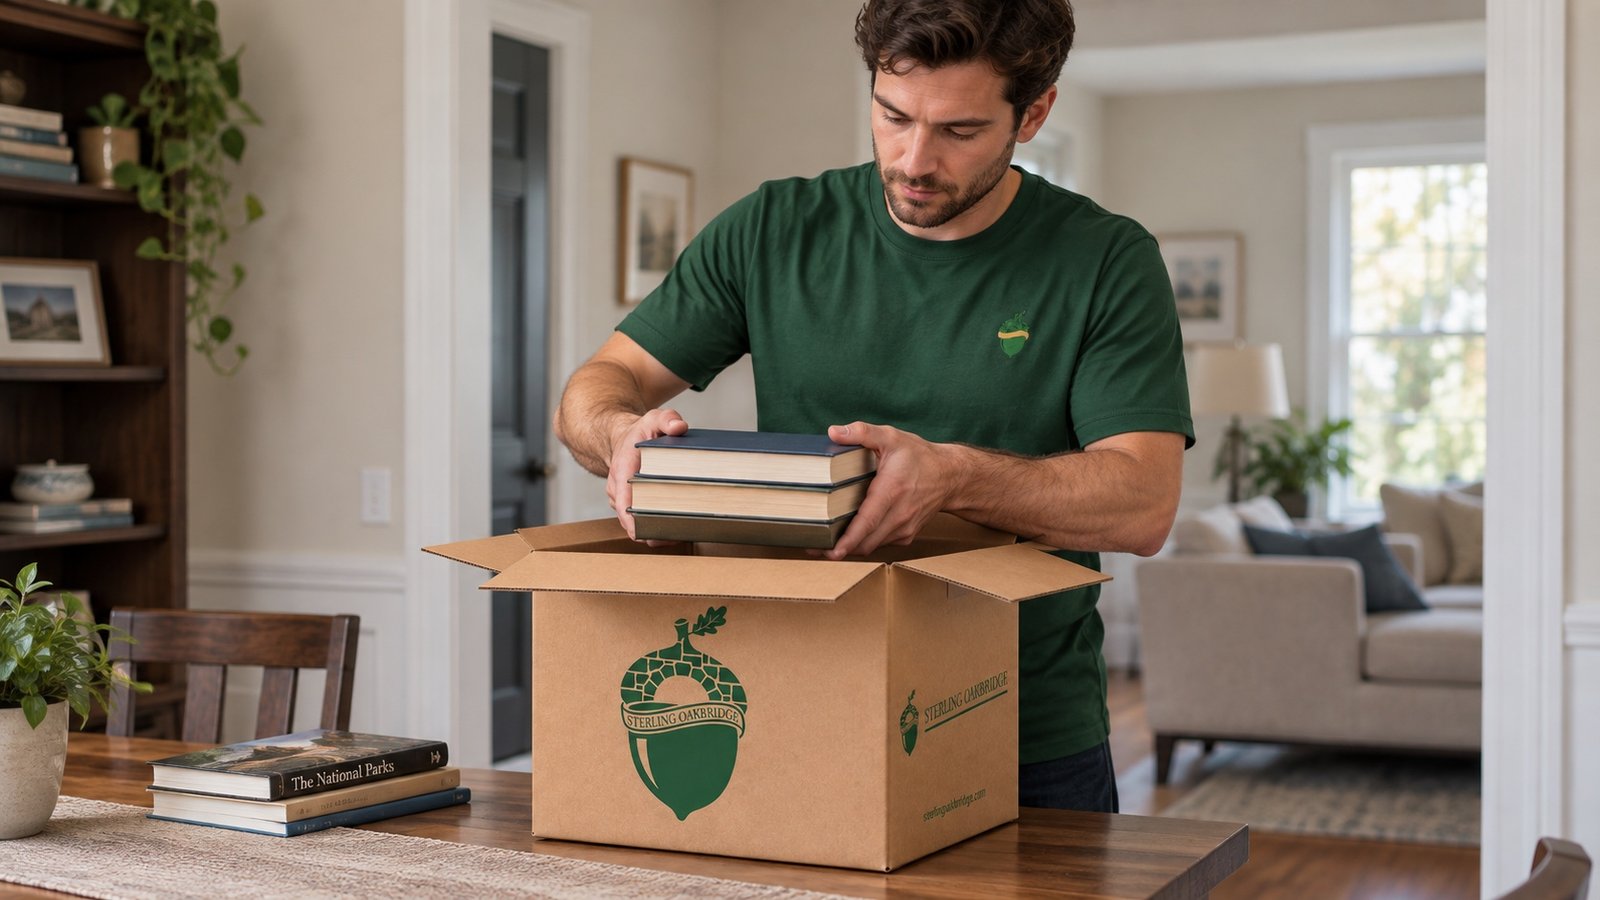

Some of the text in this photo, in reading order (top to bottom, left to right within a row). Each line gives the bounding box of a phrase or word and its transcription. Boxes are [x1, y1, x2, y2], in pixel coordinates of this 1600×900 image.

[924, 670, 1008, 724] STERLING OAKBRIDGE
[627, 707, 739, 728] STERLING OAKBRIDGE
[291, 759, 395, 792] The National Parks
